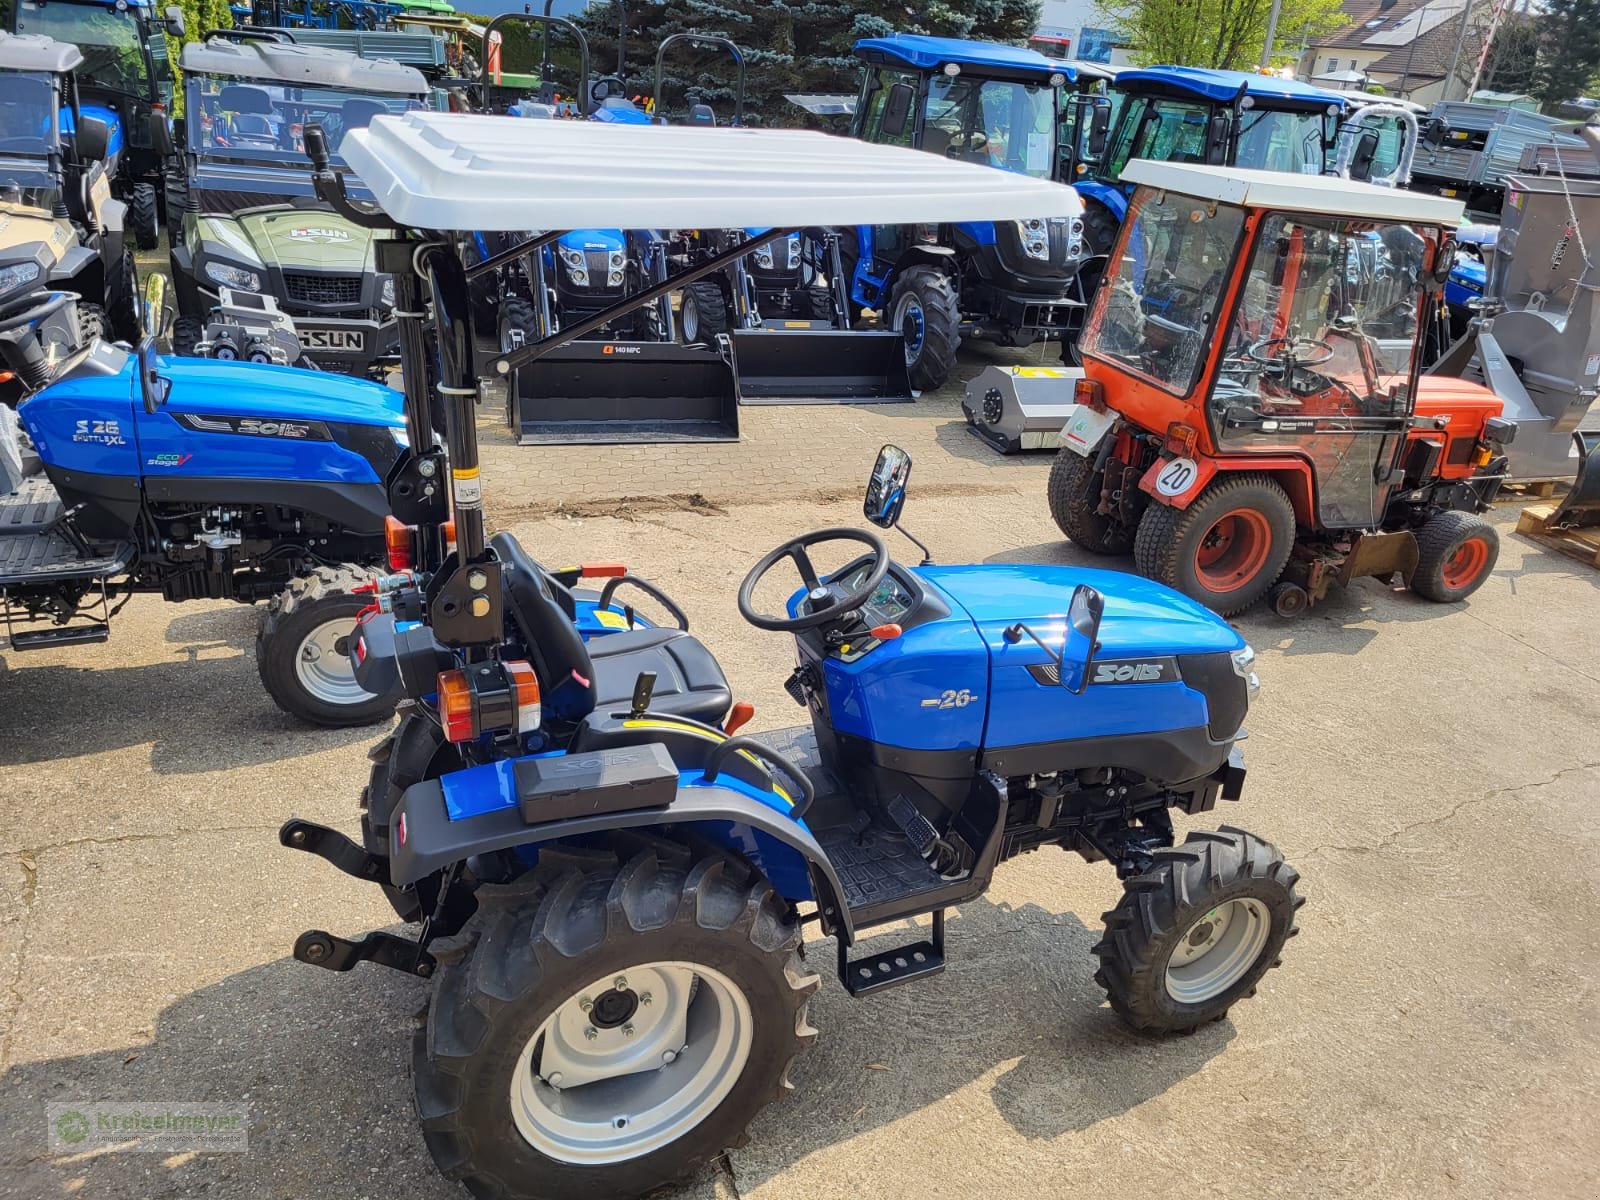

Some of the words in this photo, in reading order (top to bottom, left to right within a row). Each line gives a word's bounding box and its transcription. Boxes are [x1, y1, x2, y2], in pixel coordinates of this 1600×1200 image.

[76, 420, 89, 434] S
[92, 420, 120, 434] 26
[1161, 462, 1191, 490] 20
